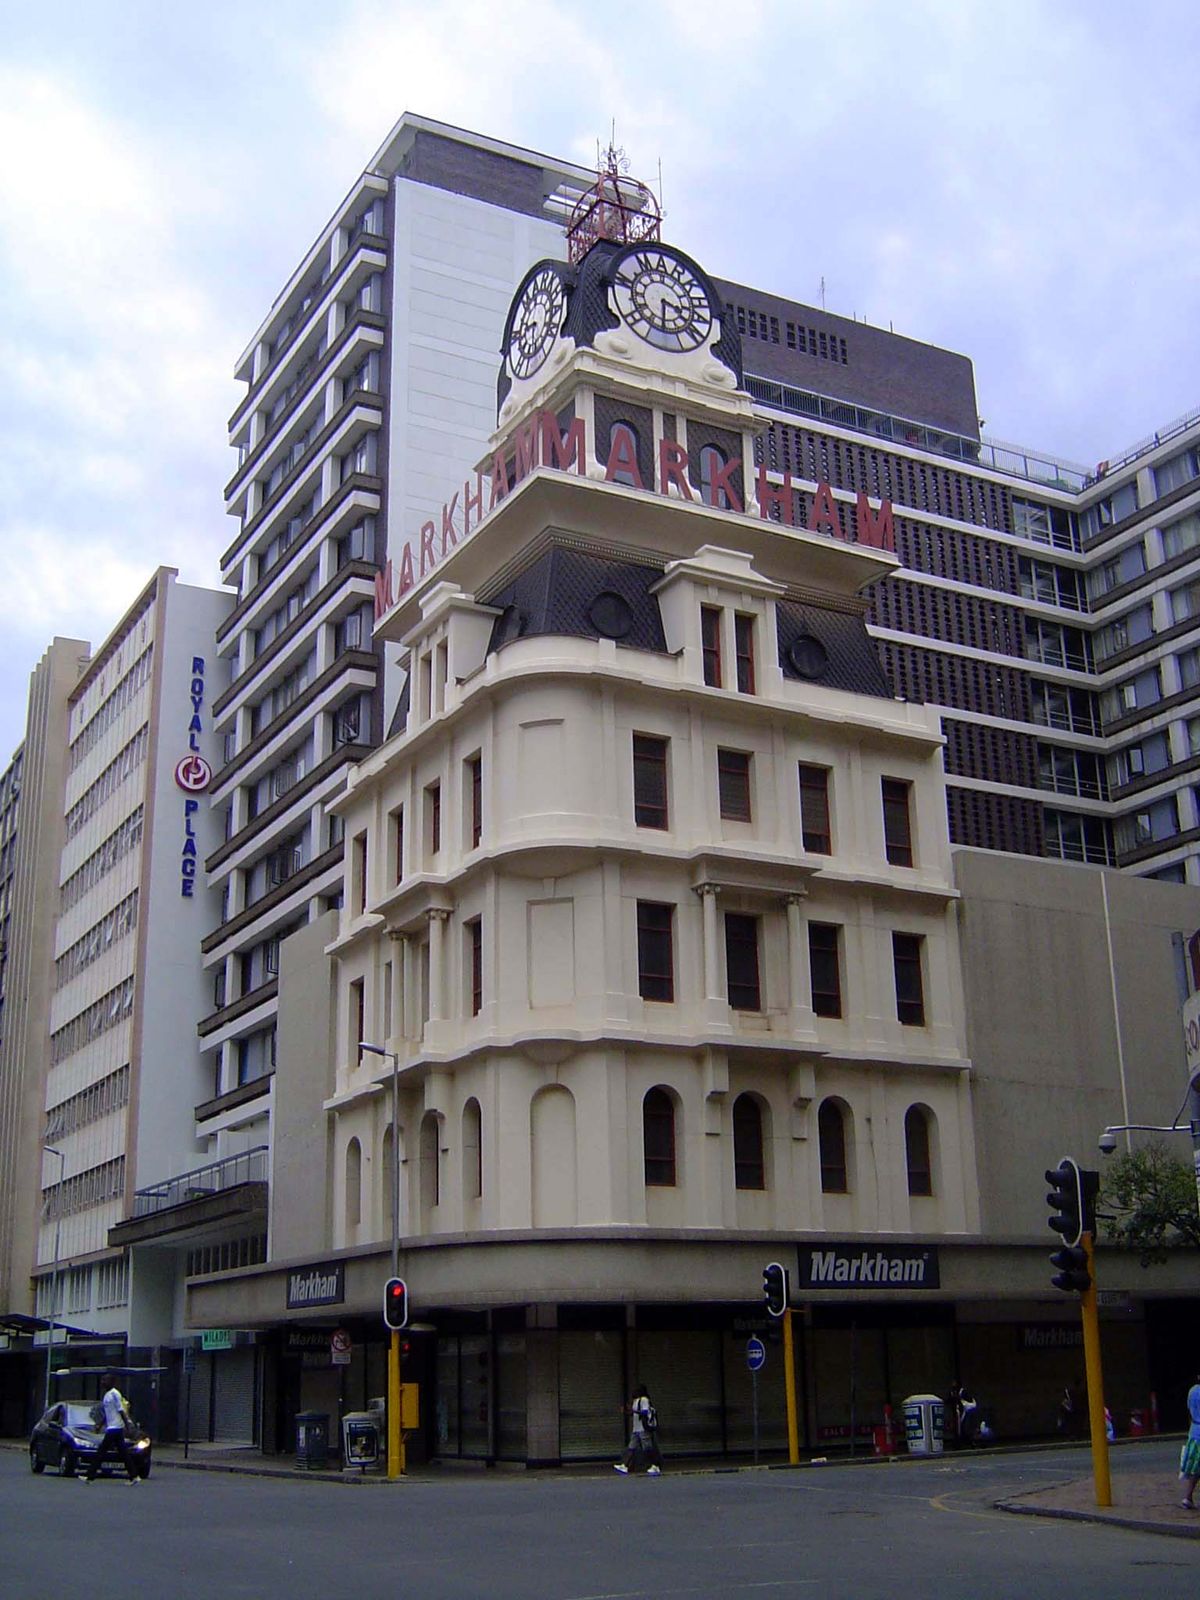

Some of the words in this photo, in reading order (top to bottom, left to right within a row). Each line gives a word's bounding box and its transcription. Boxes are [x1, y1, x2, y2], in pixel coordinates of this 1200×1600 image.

[635, 251, 710, 345] MARKHAM
[374, 410, 546, 623] MARKHAM
[542, 409, 895, 553] MARKHAM
[188, 656, 205, 753] ROYAL
[181, 799, 198, 898] PLACE
[290, 1271, 337, 1302] Markham
[810, 1251, 925, 1281] Markham
